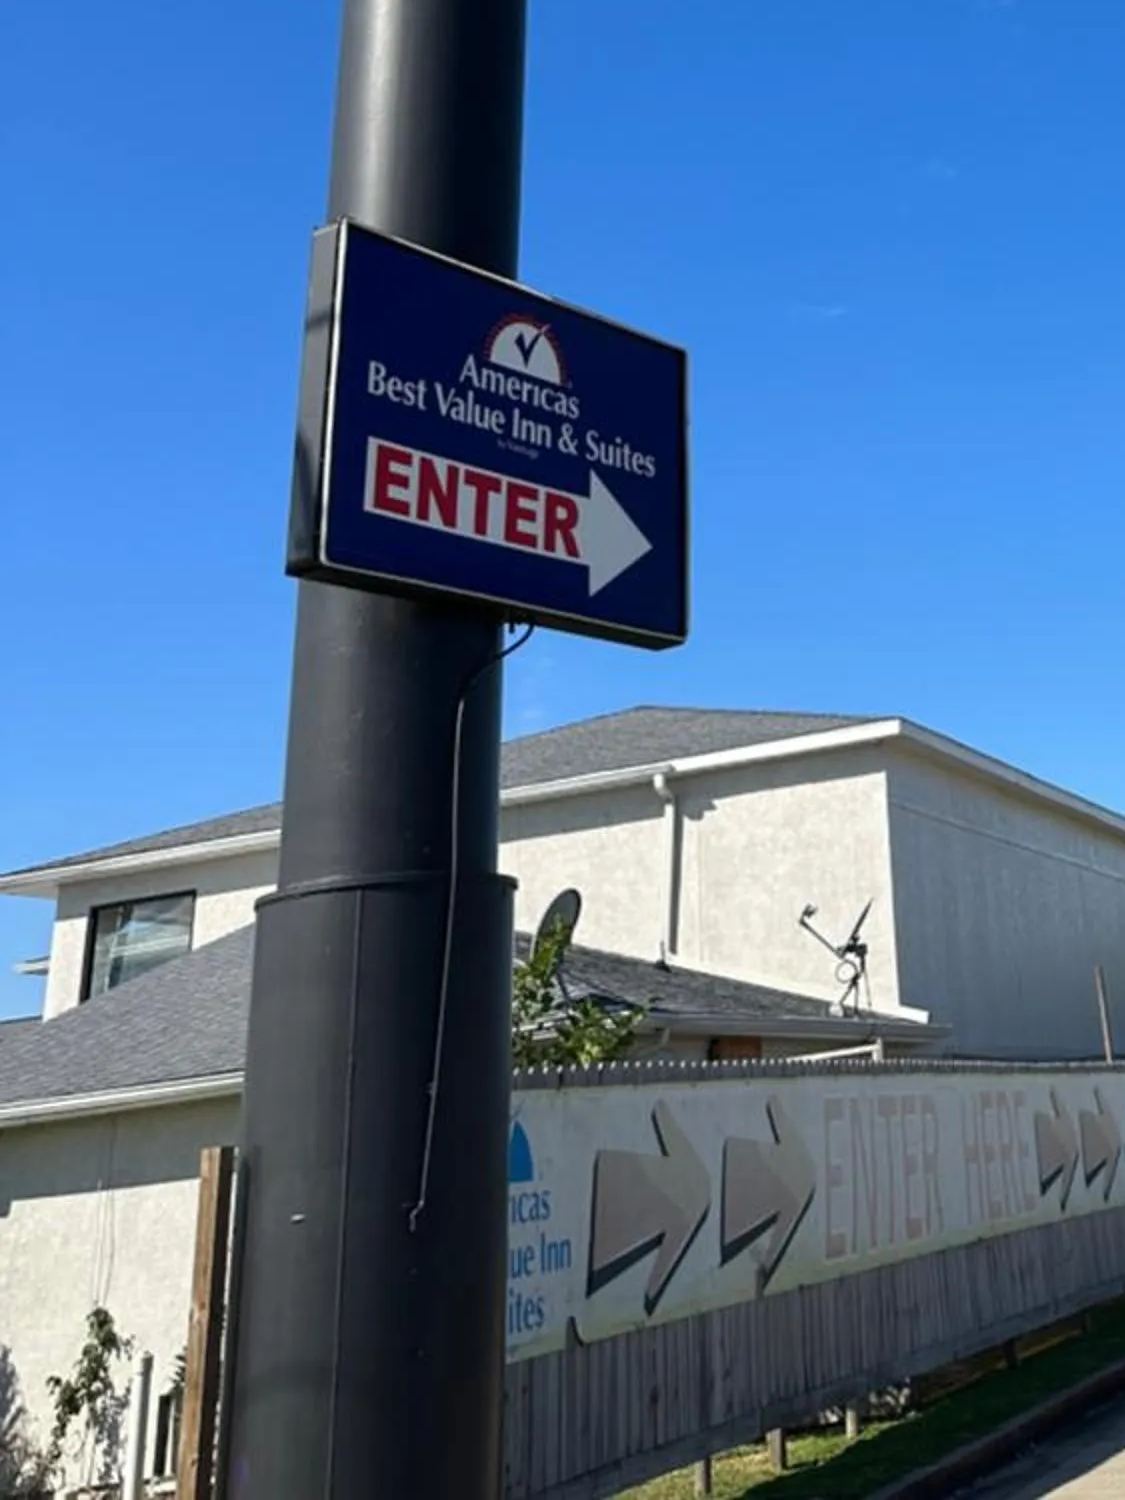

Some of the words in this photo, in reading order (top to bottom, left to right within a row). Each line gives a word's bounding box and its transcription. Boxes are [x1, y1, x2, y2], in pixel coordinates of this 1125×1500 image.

[458, 354, 580, 419] Americas
[367, 360, 427, 412] Best
[434, 382, 505, 435] Value
[511, 408, 552, 450] Inn
[558, 426, 578, 457] &
[585, 430, 657, 479] Suites
[372, 443, 581, 560] ENTER
[511, 1190, 551, 1225] icas
[822, 1093, 945, 1260] ENTER
[540, 1232, 572, 1275] Inn
[509, 1288, 545, 1335] ites
